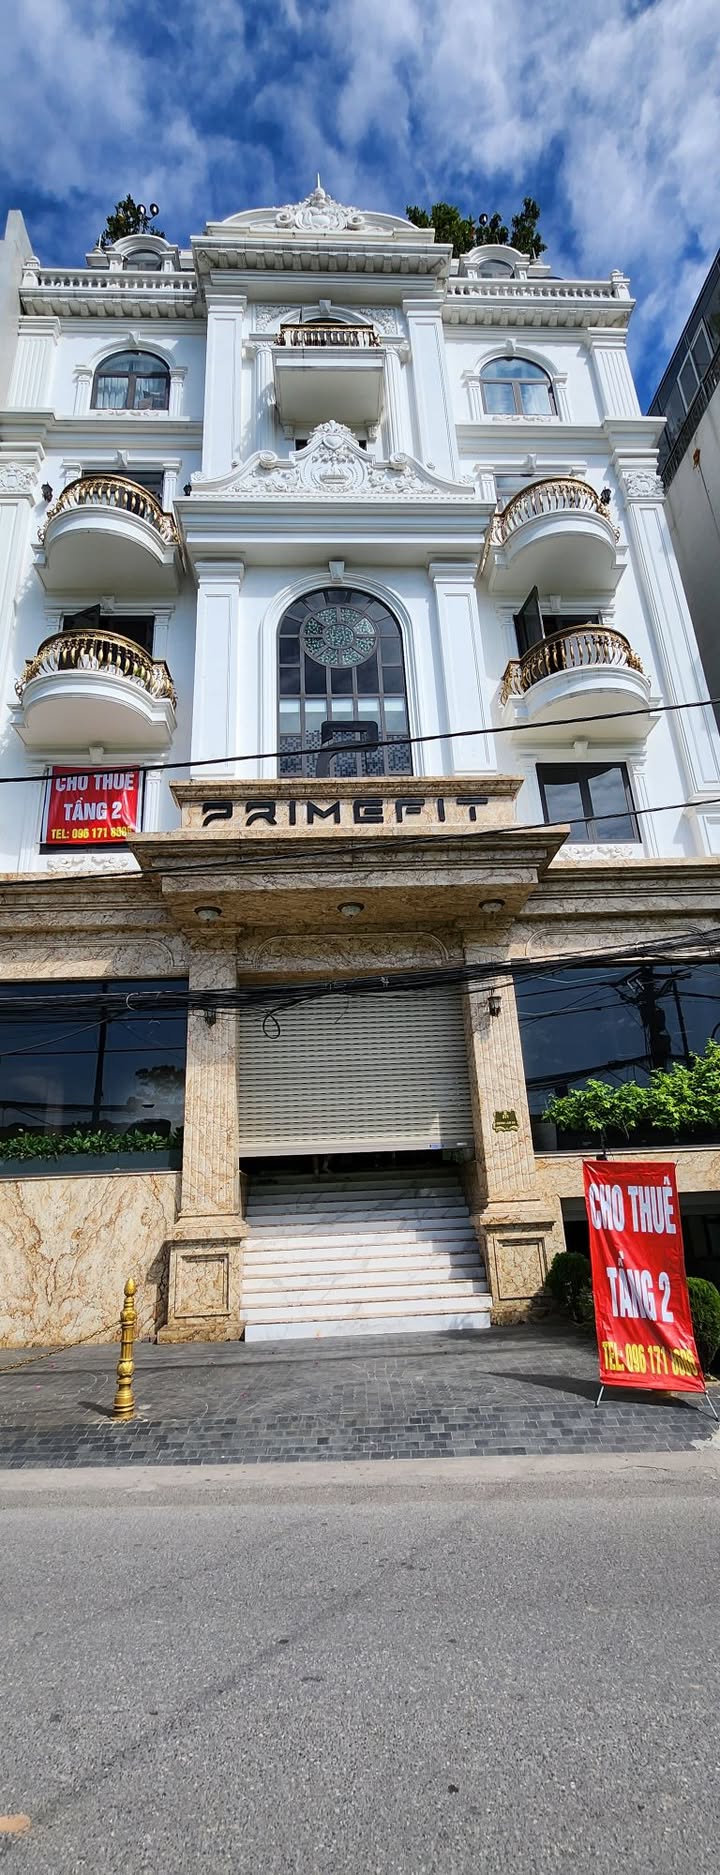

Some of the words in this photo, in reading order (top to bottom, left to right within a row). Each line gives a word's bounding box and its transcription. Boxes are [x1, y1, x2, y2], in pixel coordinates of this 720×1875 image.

[55, 775, 89, 792] CHO
[63, 796, 108, 821] TẦNG
[111, 801, 123, 820] 2
[201, 797, 489, 827] PRIMEFIT
[51, 828, 70, 840] TEL:
[71, 828, 90, 839] 096
[92, 827, 108, 838] 171
[588, 1182, 625, 1233] CHO
[627, 1176, 677, 1235] THUÊ
[606, 1250, 658, 1322] TẦNG
[658, 1271, 675, 1323] 2
[625, 1342, 647, 1375] 096
[647, 1345, 669, 1376] 171
